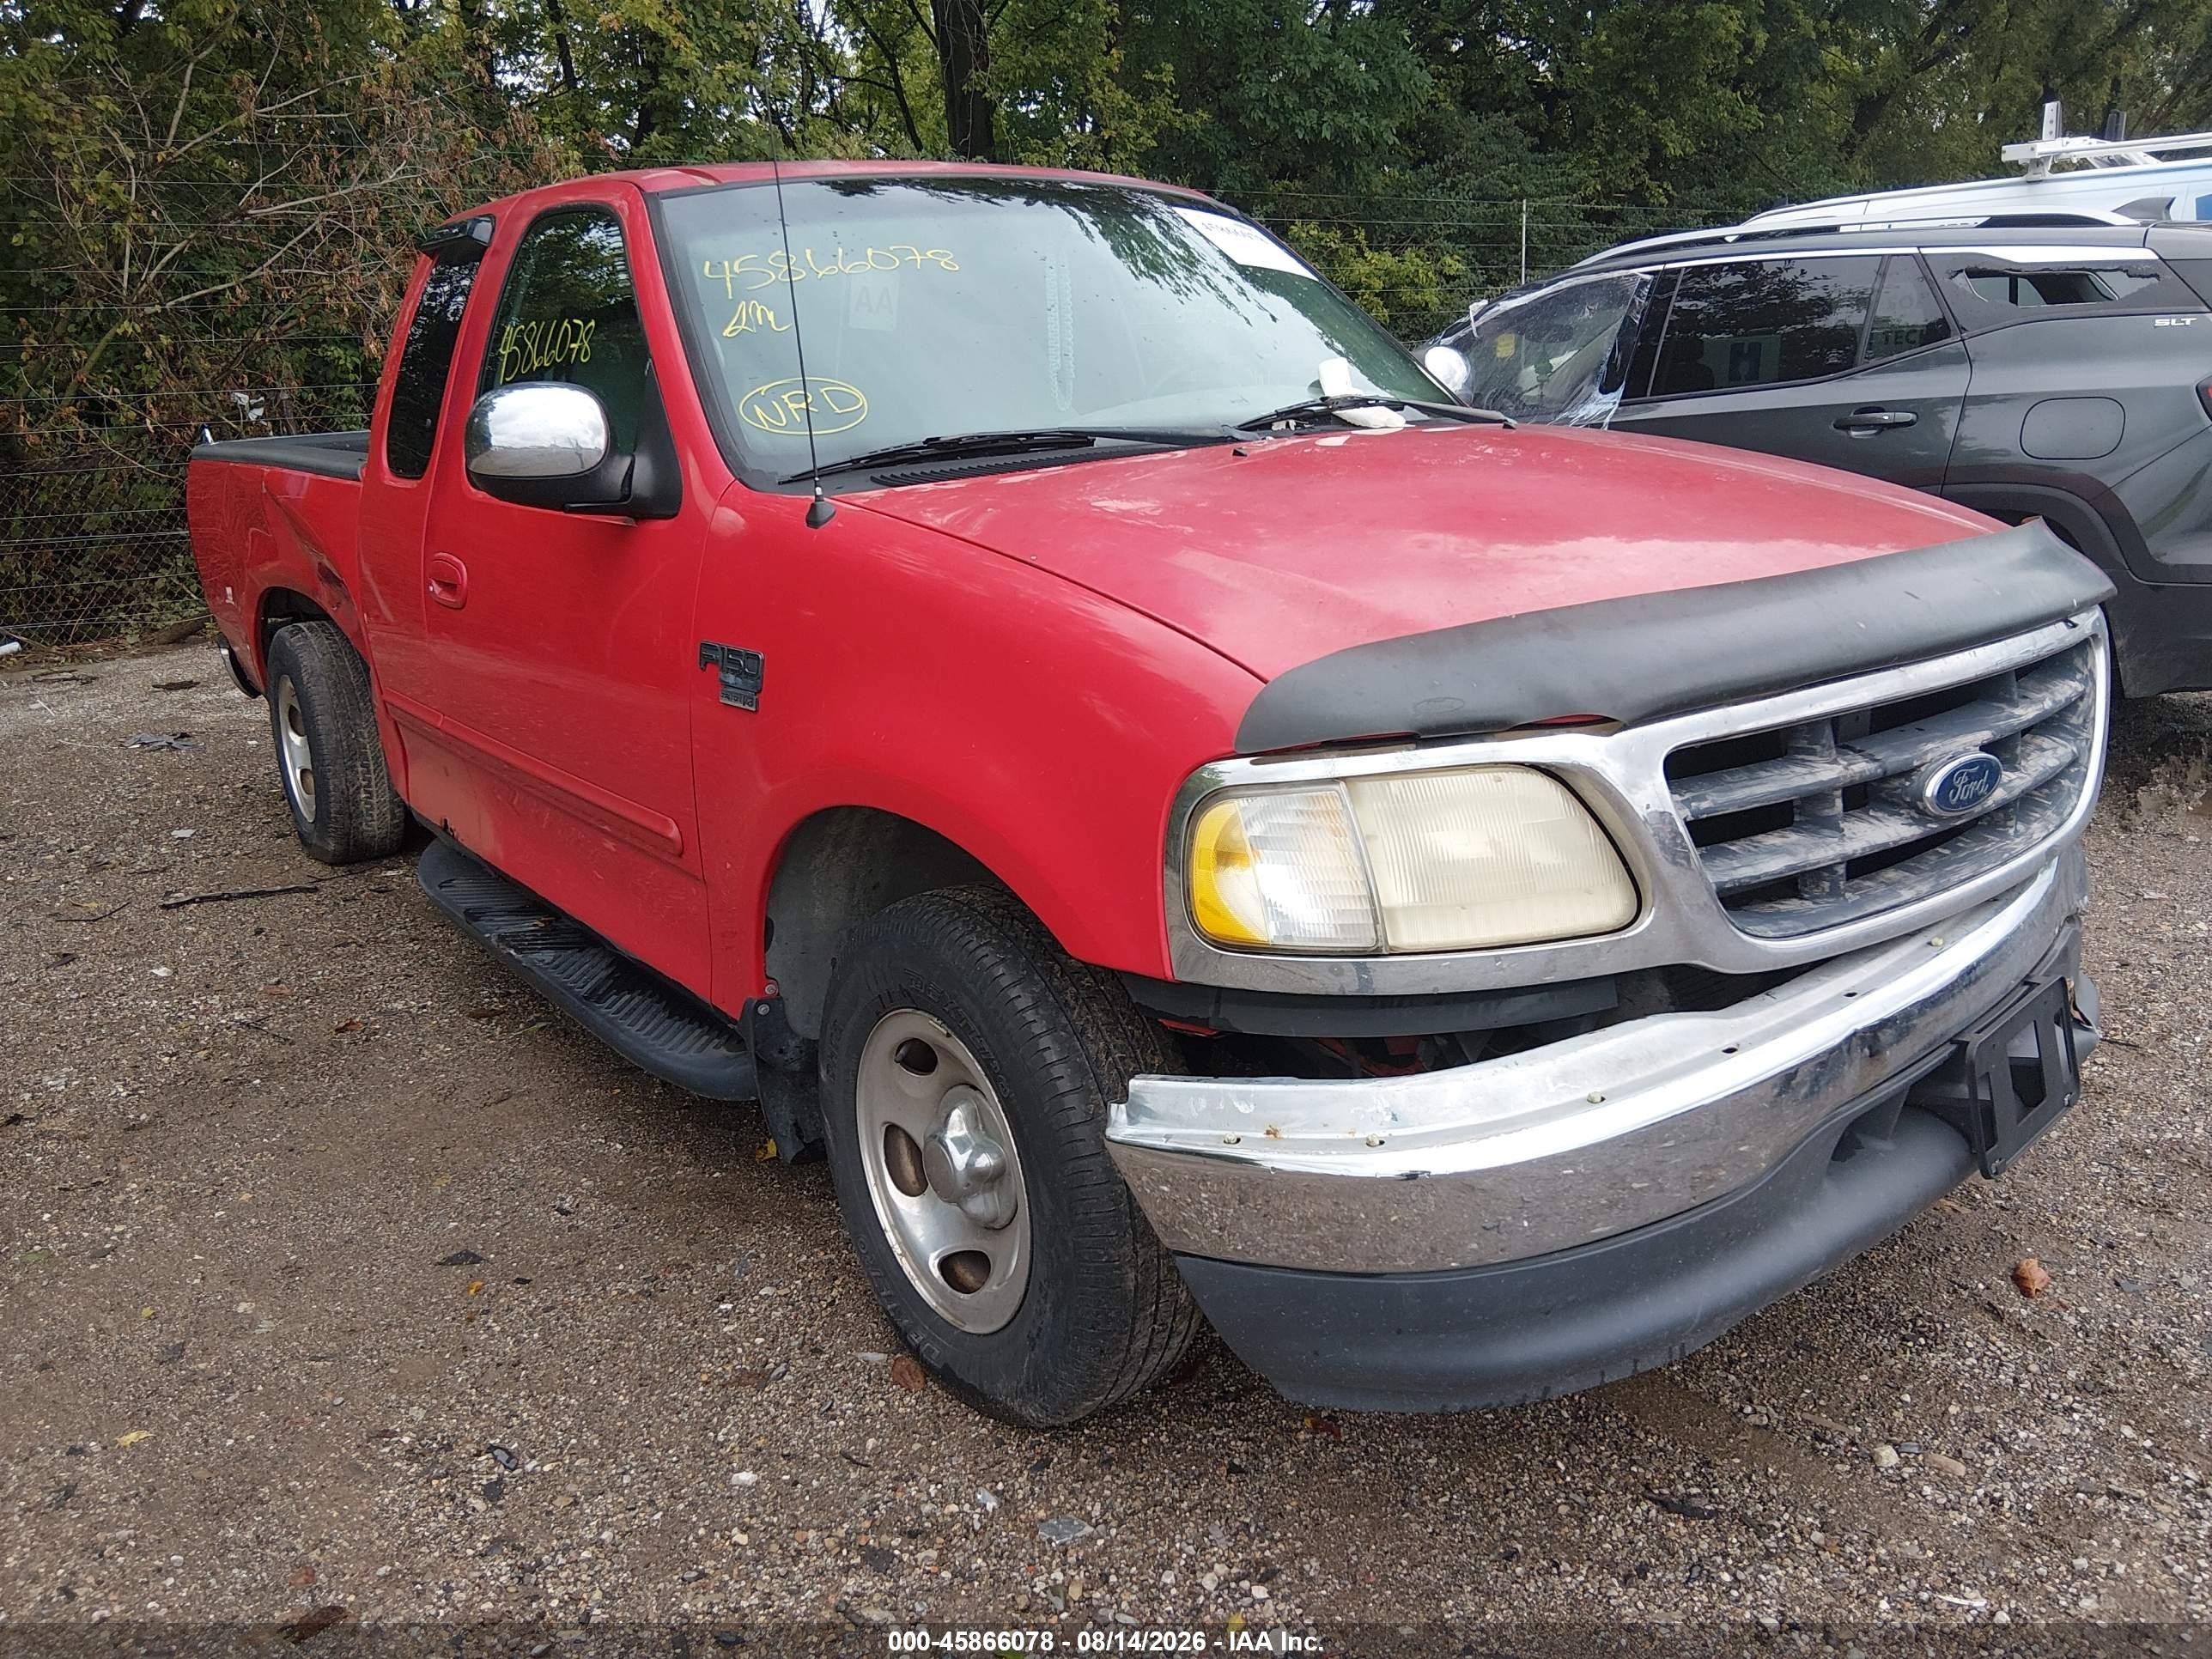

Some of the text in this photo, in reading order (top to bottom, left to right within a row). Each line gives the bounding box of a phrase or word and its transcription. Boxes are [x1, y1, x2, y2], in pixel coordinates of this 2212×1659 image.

[703, 244, 961, 299] 45866078
[2154, 317, 2198, 327] SLT
[499, 318, 596, 386] 45866078
[753, 386, 864, 429] NRD
[1948, 765, 1990, 805] Ford
